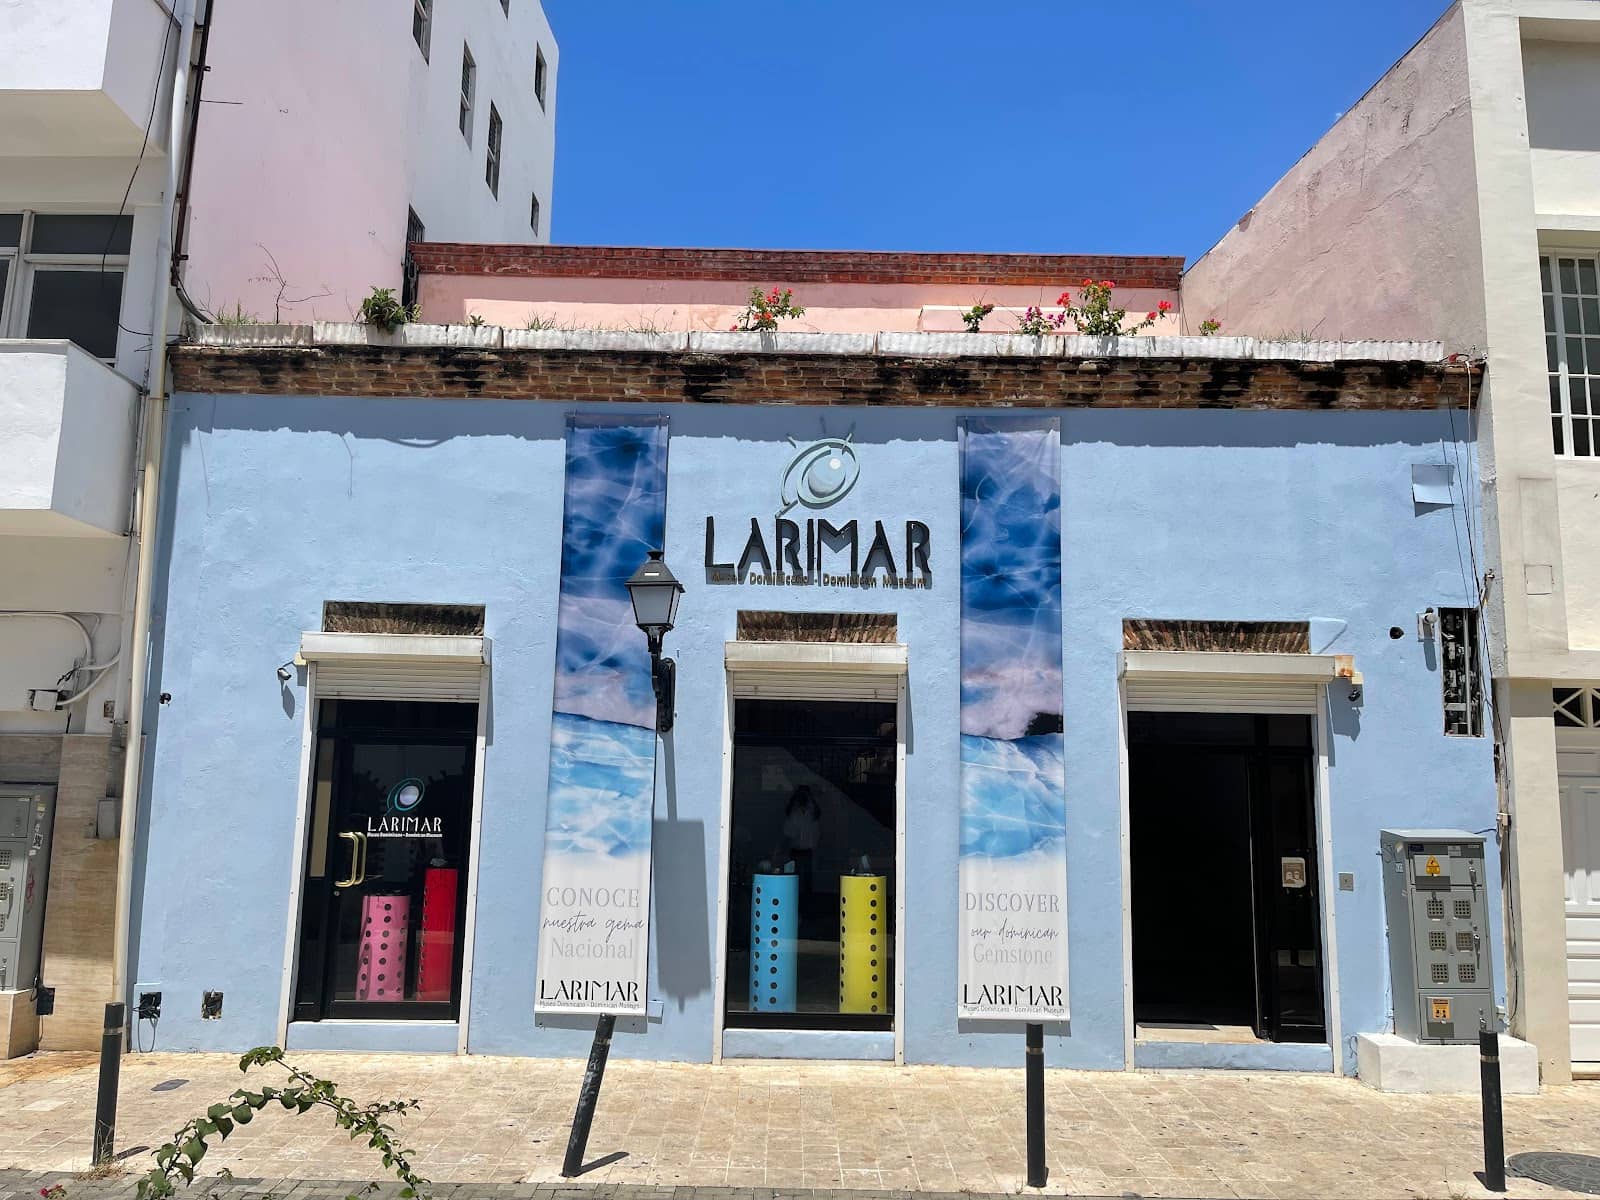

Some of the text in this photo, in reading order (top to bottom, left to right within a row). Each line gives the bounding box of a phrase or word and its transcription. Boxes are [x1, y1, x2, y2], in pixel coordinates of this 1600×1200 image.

[704, 516, 932, 574] LARIMAR
[367, 816, 442, 832] LARIMAR
[546, 887, 641, 908] CONOCE
[965, 892, 1060, 913] DISCOVER
[543, 912, 645, 943] nuestra gema
[998, 917, 1060, 944] dominican
[551, 937, 633, 960] Nacional
[973, 943, 1053, 965] Gemstone
[540, 979, 639, 1002] LARIMAR
[963, 983, 1063, 1006] LARIMAR
